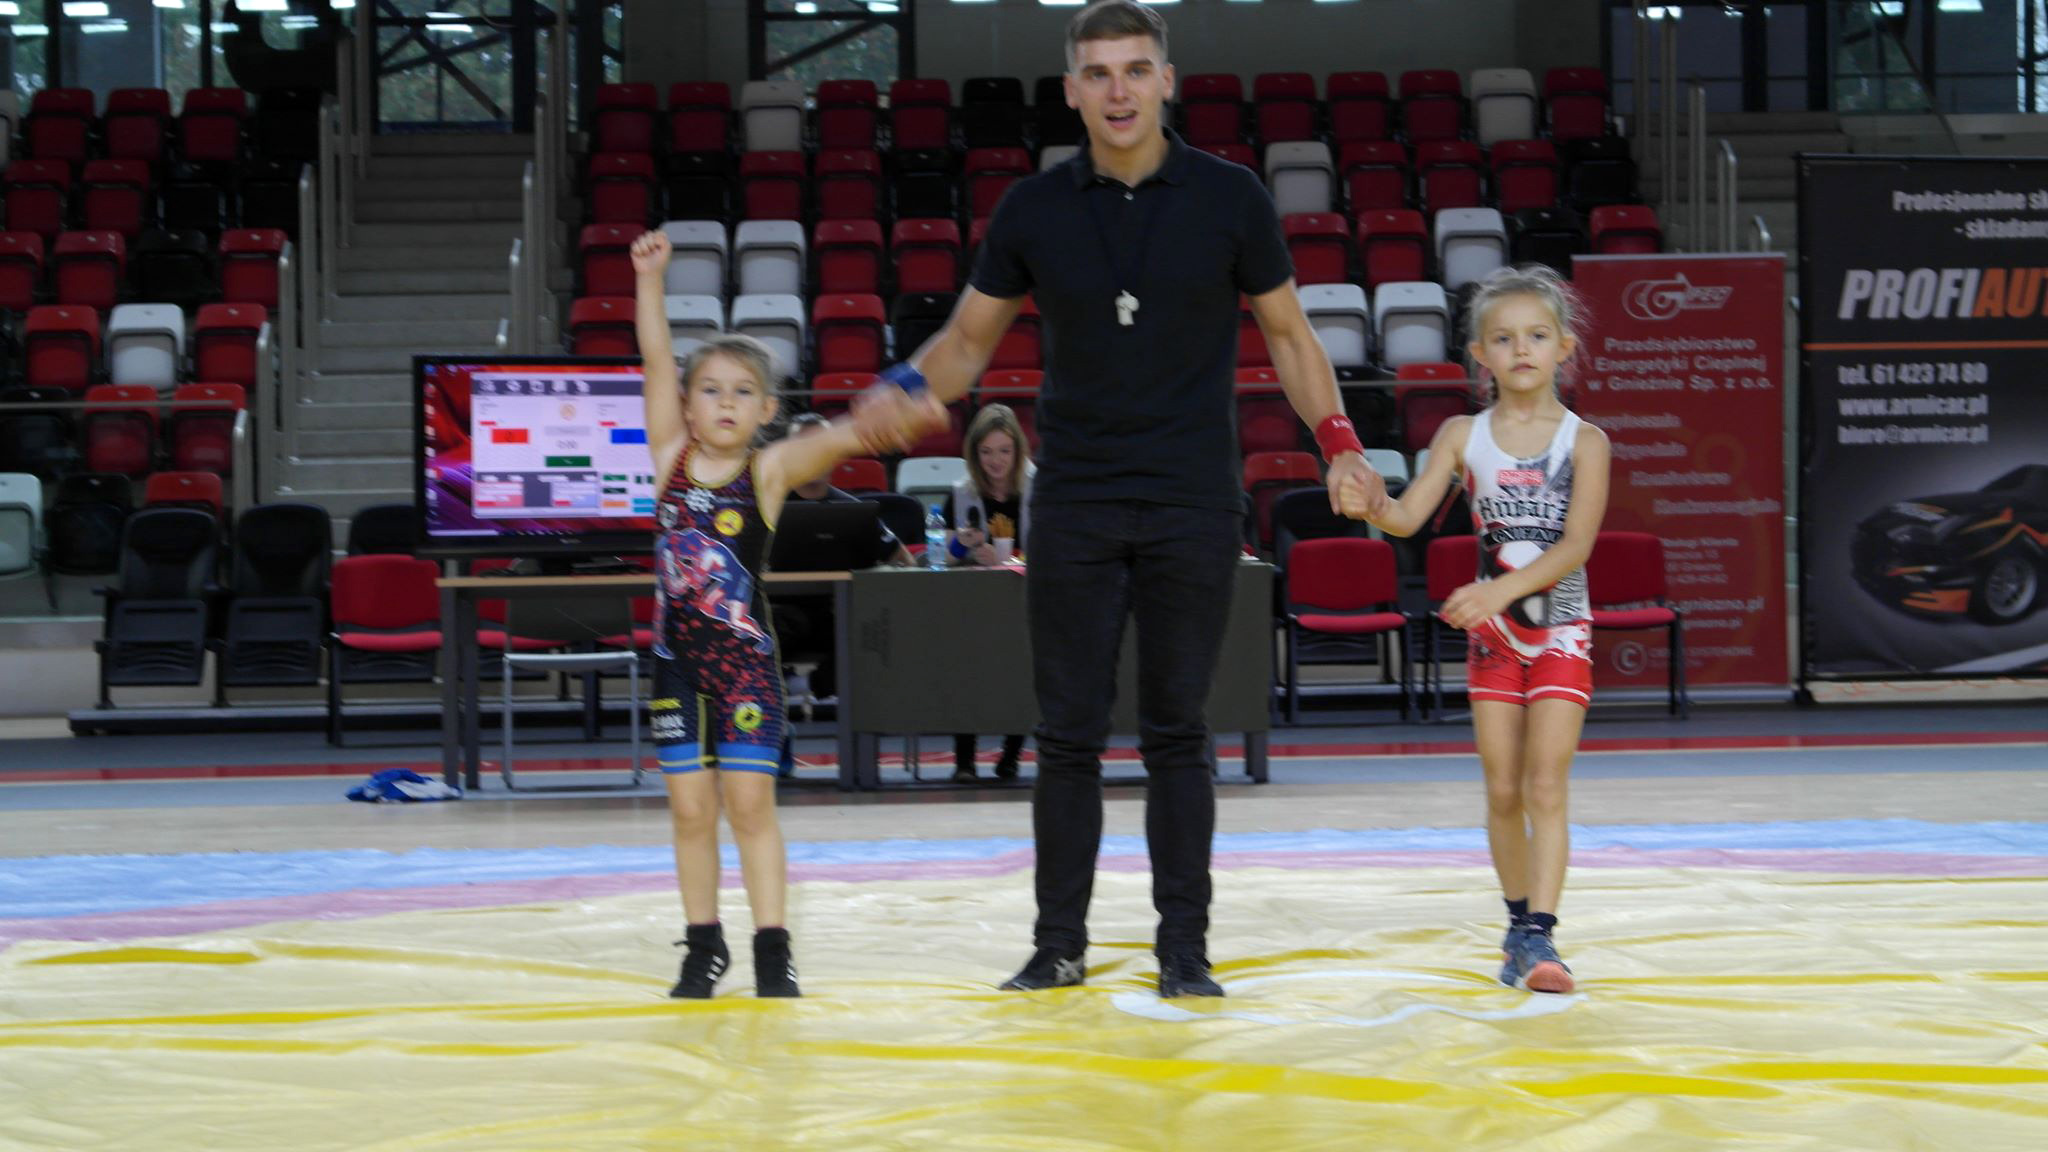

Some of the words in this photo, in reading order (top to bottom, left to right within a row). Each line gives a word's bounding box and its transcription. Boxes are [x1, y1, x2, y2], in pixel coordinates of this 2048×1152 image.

[1892, 190, 2026, 212] Profesjonalne
[1595, 356, 1689, 373] Energetyki
[1586, 377, 1601, 390] w
[1690, 375, 1717, 391] Sp.
